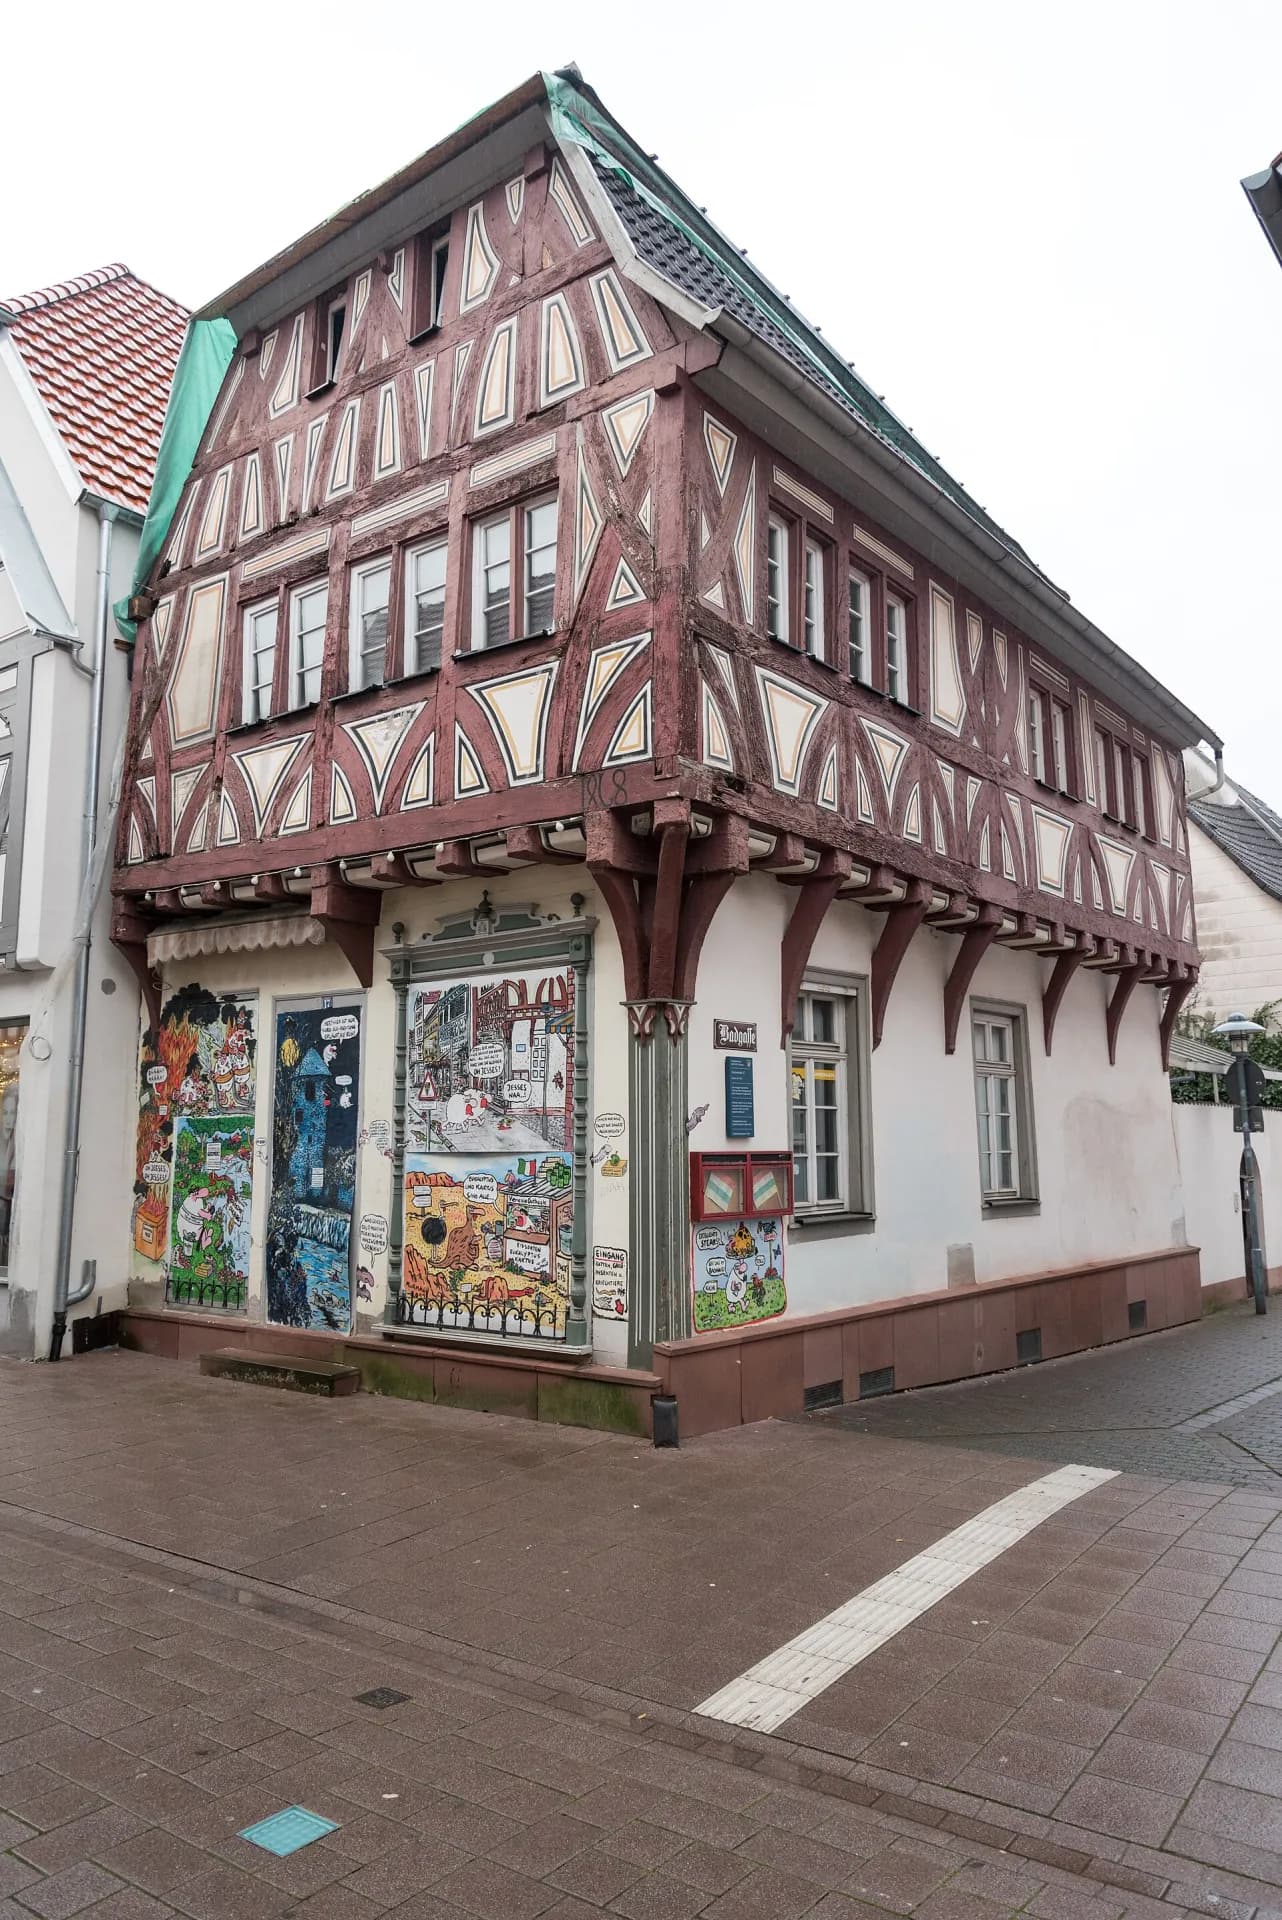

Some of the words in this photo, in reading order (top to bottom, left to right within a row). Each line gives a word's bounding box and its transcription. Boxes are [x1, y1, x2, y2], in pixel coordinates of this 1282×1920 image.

[324, 999, 331, 1008] 17
[481, 1065, 501, 1076] JESSES!
[507, 1083, 527, 1092] JESSES
[595, 1249, 625, 1261] EINGANG
